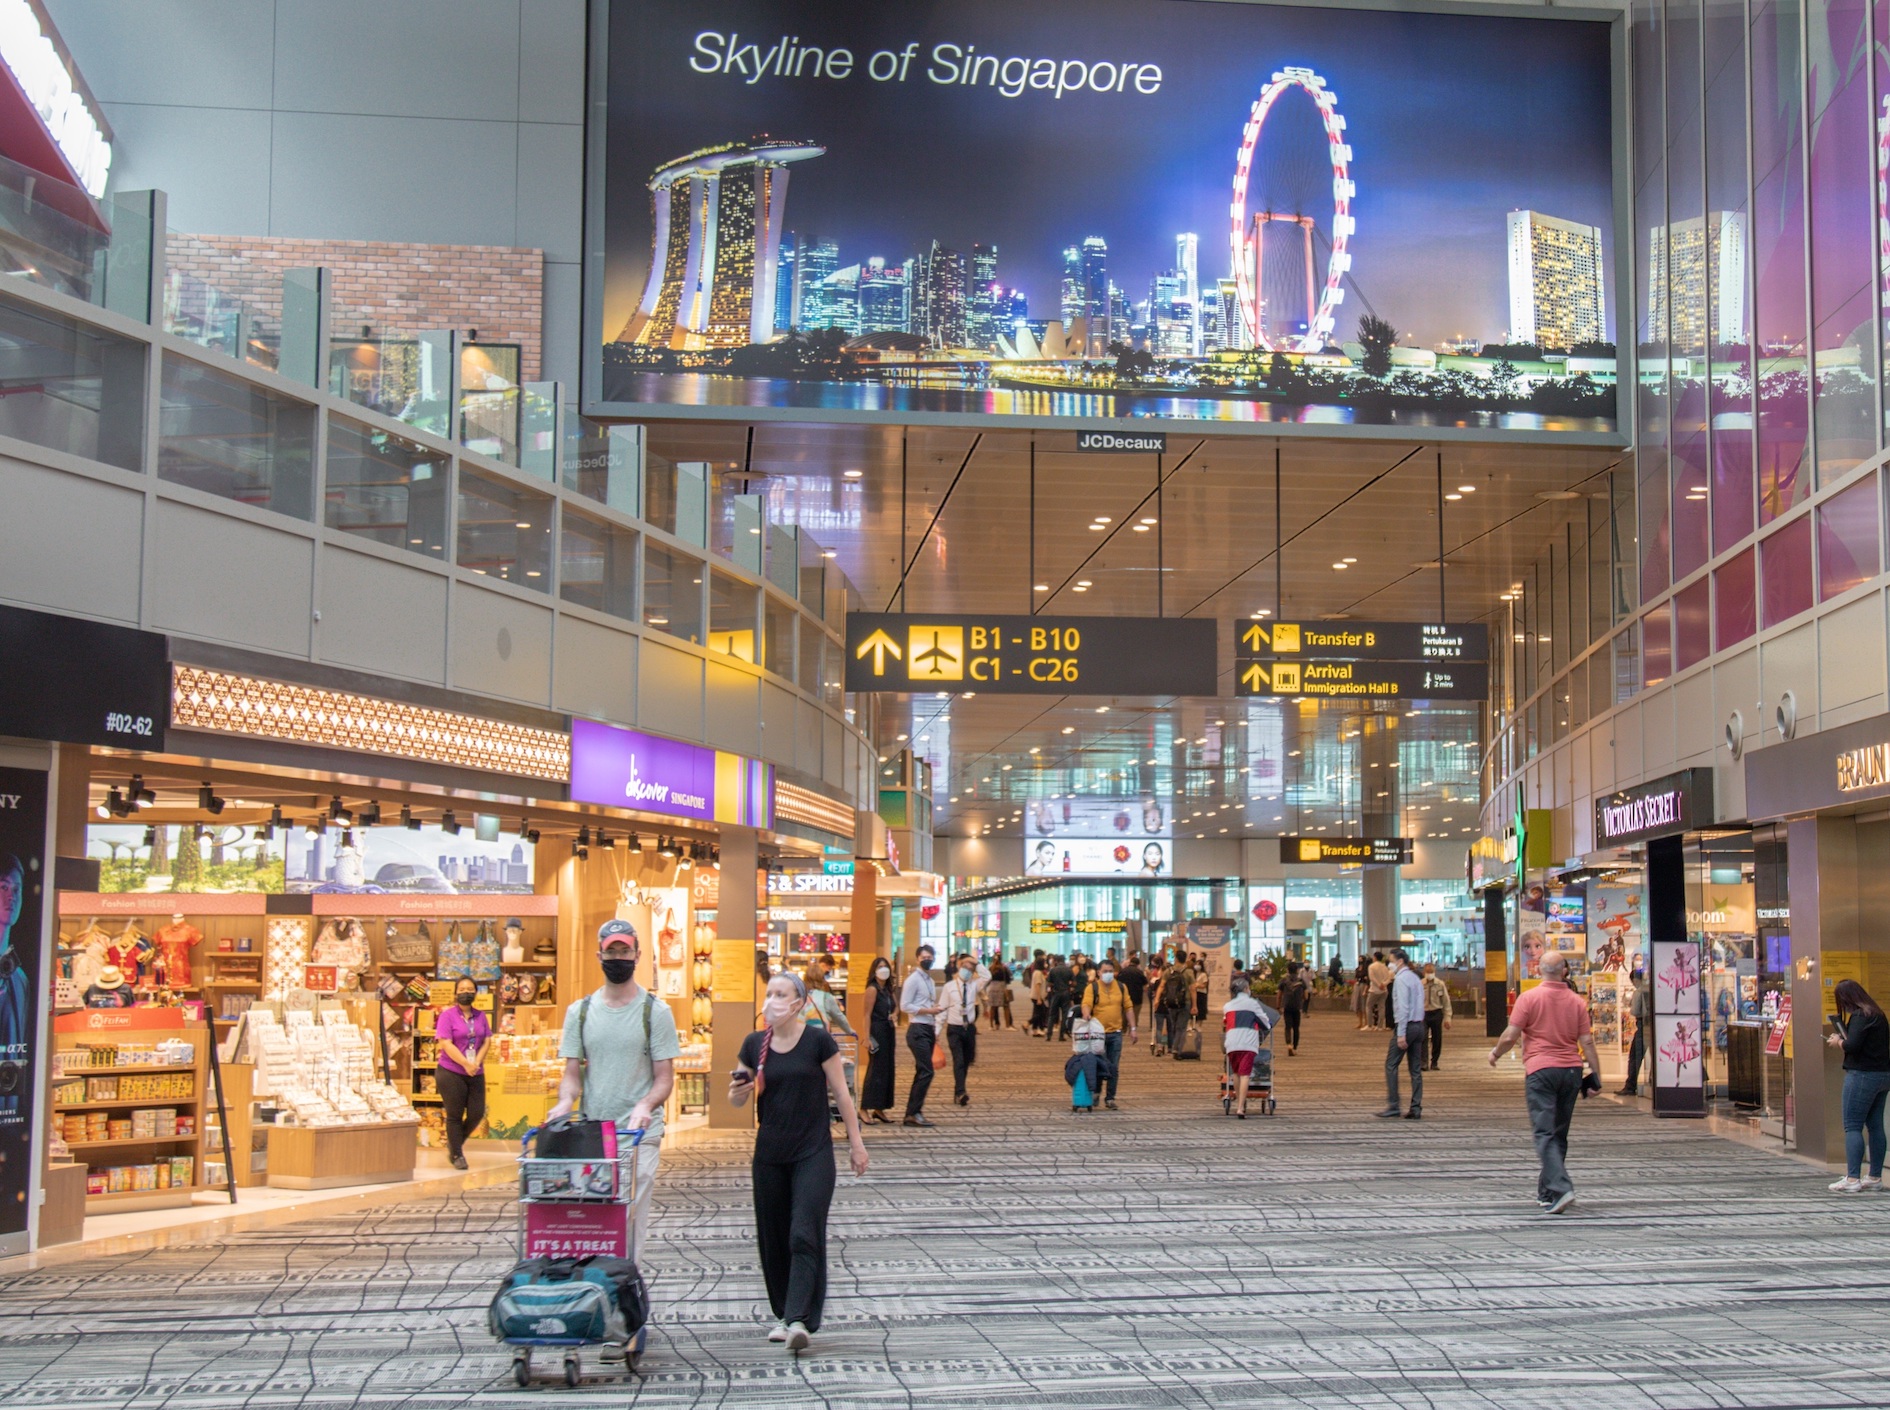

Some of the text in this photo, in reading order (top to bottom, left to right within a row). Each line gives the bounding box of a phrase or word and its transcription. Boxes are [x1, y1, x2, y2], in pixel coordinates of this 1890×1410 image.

[689, 31, 1163, 99] Skyline of Singapore
[1080, 434, 1163, 450] JCDecaux
[970, 626, 1001, 650] B1
[1030, 627, 1081, 651] B10
[1304, 631, 1376, 647] Transfer B
[1423, 637, 1463, 646] Pertukaran B
[969, 656, 1001, 681] C1
[1028, 657, 1080, 682] C26
[1304, 664, 1353, 679] Arrival
[1434, 674, 1443, 682] Up
[1304, 682, 1399, 696] Immigration Hall B
[106, 712, 153, 736] #02-62
[625, 753, 706, 809] discover SINGAPORE
[1603, 791, 1675, 837] VICTORIA'S SECRET
[1321, 845, 1371, 856] Transfer B
[833, 864, 851, 874] EXIT
[778, 875, 792, 892] &
[795, 875, 854, 892] SPIRITS
[102, 899, 136, 909] Fashion
[400, 900, 434, 909] Fashion
[533, 1240, 617, 1251] IT'S A TREAT
